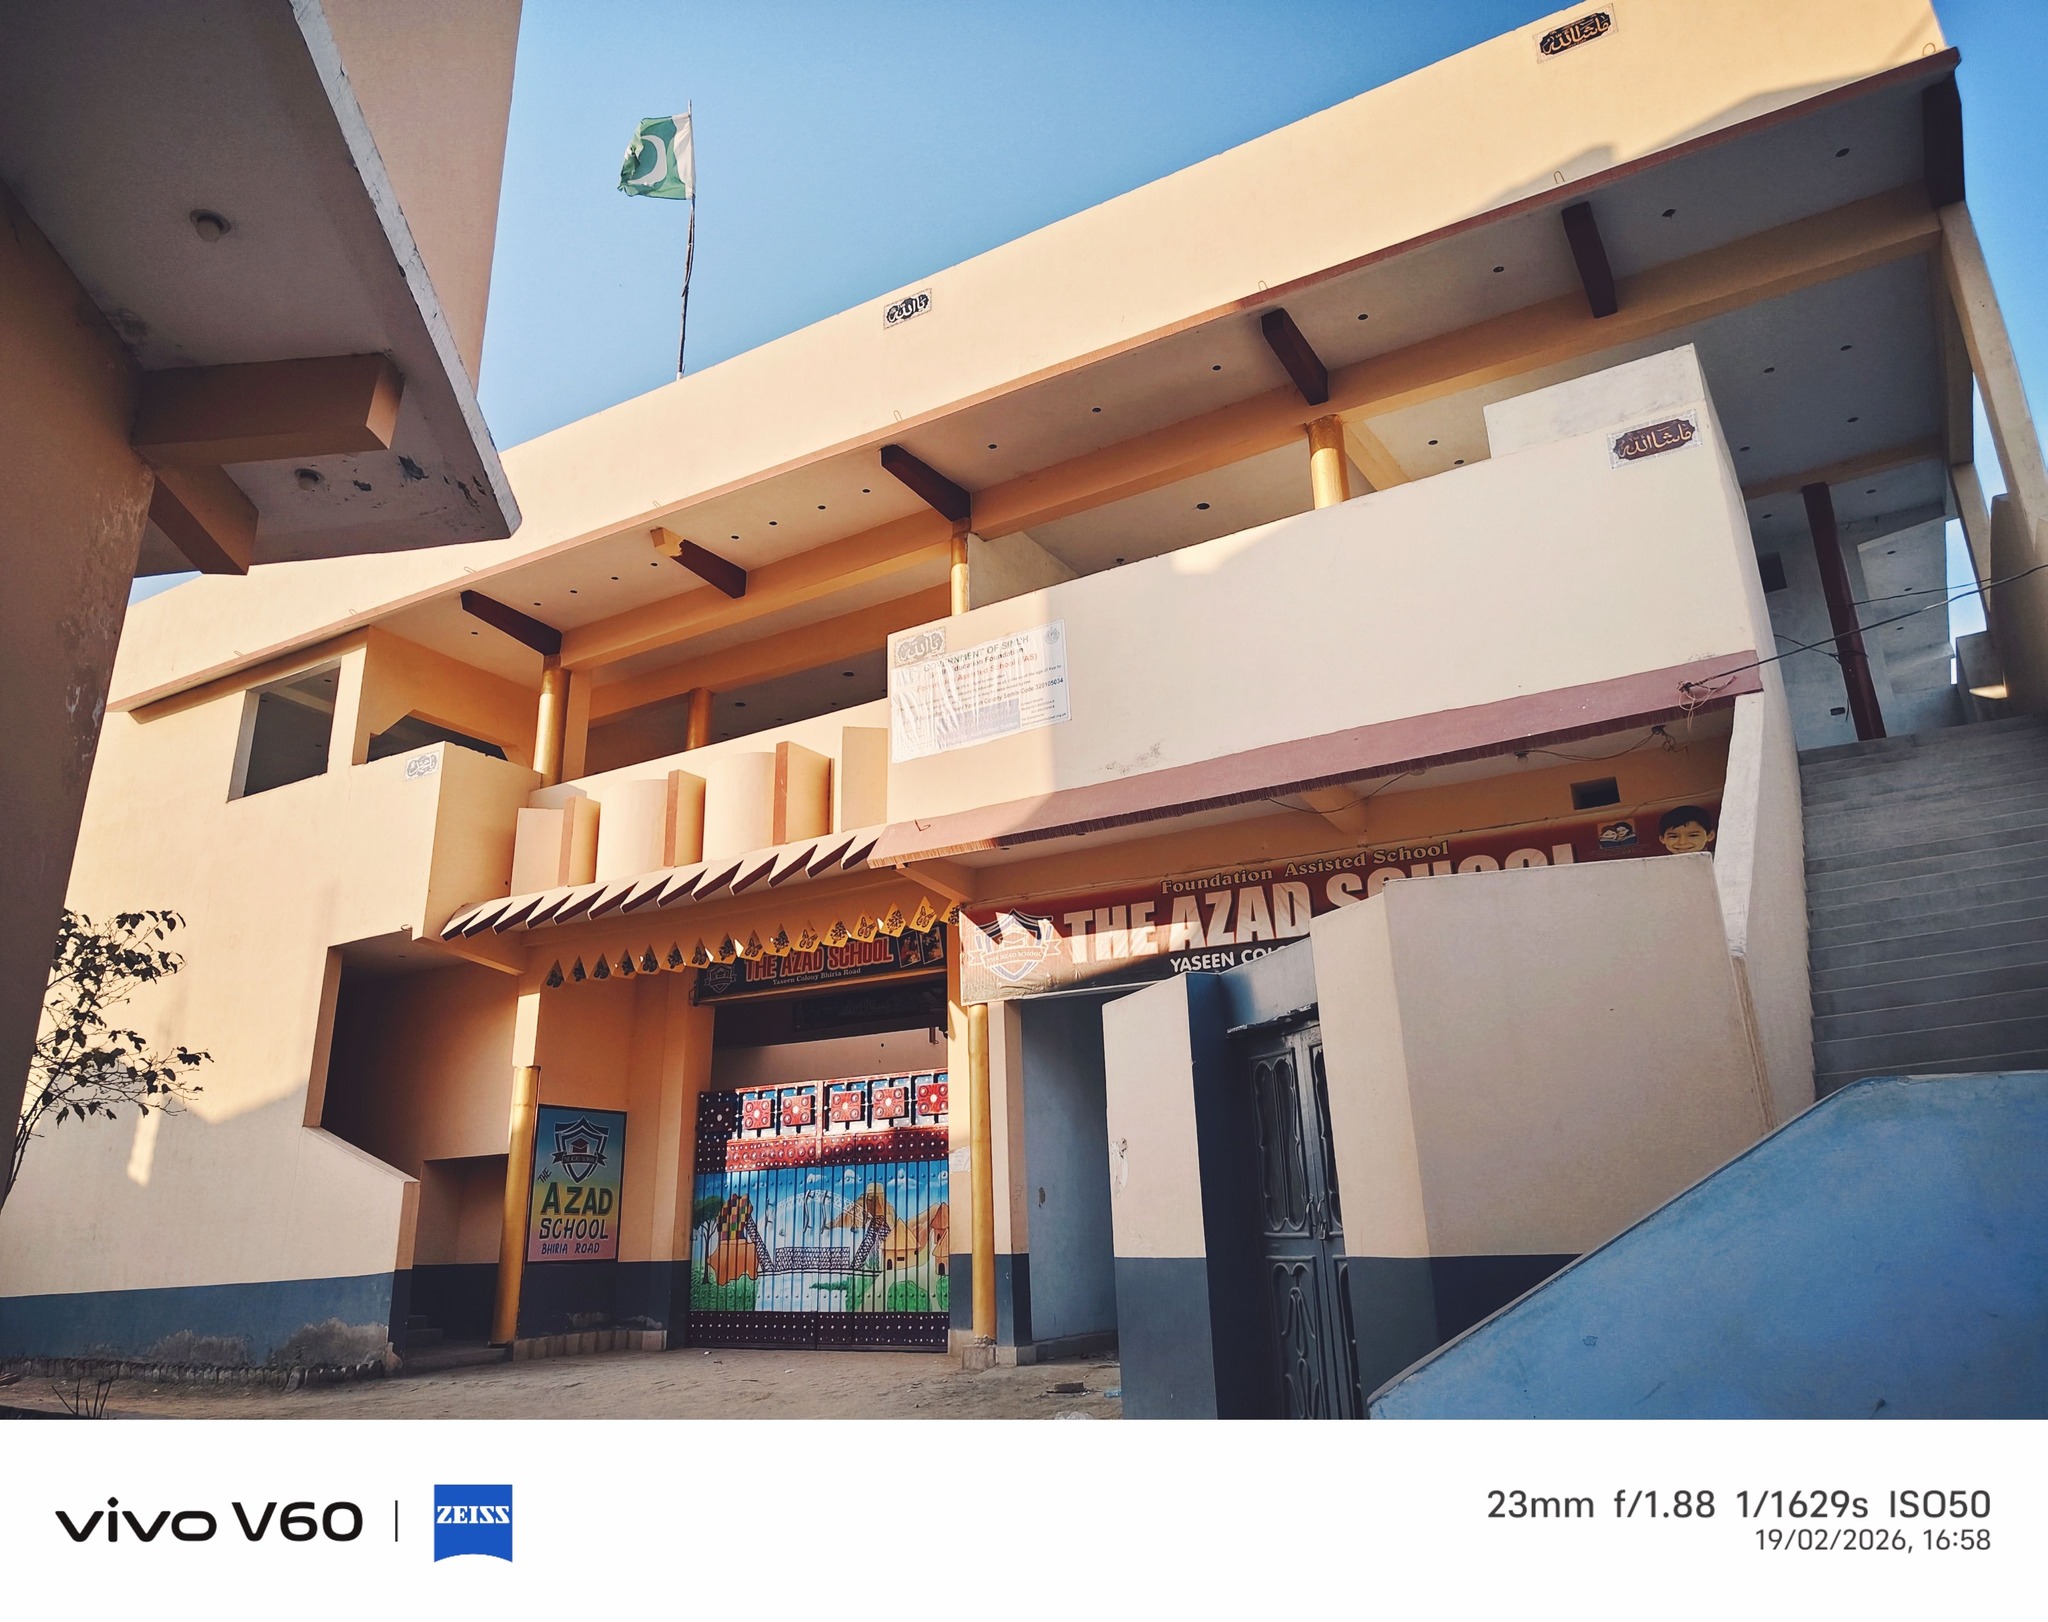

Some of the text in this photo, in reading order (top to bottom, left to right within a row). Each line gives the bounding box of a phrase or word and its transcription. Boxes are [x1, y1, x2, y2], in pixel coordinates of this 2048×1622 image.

[987, 643, 999, 654] OF
[1162, 840, 1449, 895] Foundation Assisted School
[1064, 882, 1312, 964] THE AZAD
[746, 936, 894, 982] THE AZAD SCHOOL
[1170, 951, 1235, 973] YASEEN
[773, 968, 861, 986] Yaseen Colony Bhiria Road
[537, 1166, 552, 1184] THE
[540, 1182, 613, 1216] AZAD
[539, 1218, 609, 1240] SCHOOL
[541, 1242, 600, 1255] BHIRIA ROAD
